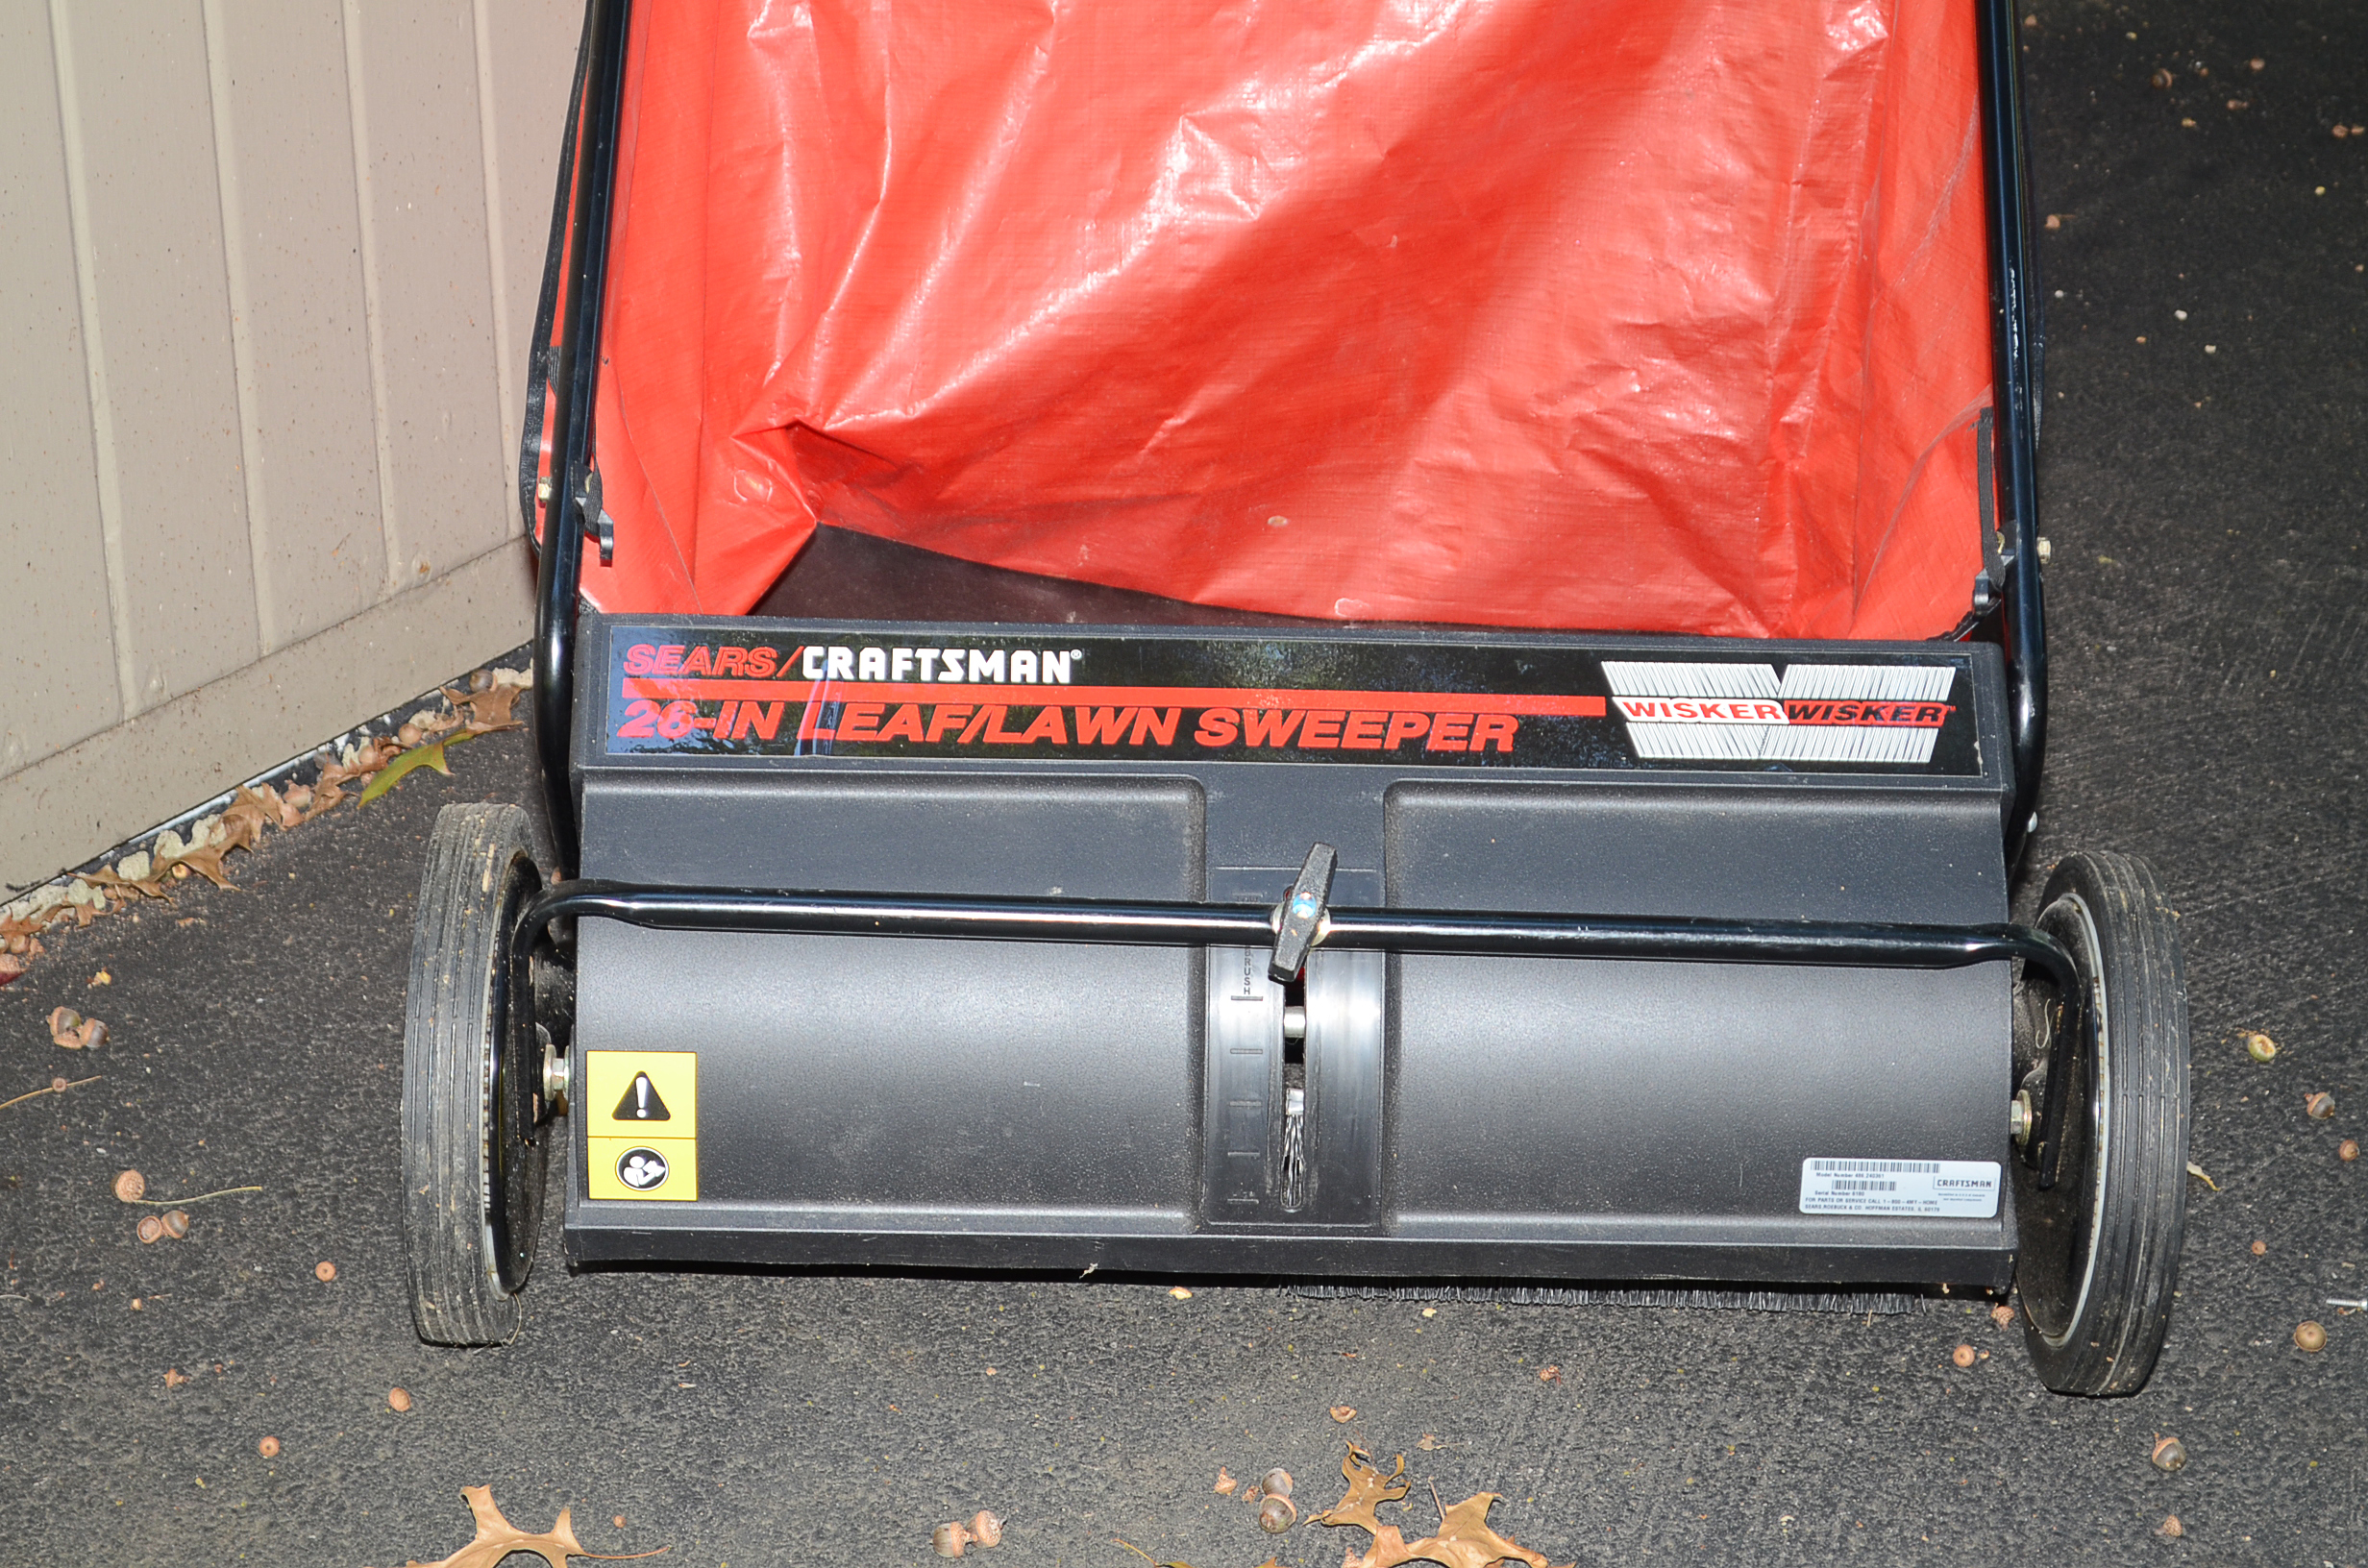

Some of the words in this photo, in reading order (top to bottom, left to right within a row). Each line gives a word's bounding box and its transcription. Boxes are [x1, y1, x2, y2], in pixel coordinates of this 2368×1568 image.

[1621, 701, 1782, 720] WISKER
[616, 699, 785, 739] 26-IN
[1194, 707, 1519, 752] SWEEPER
[1936, 1179, 1992, 1188] CRAFTSMAN
